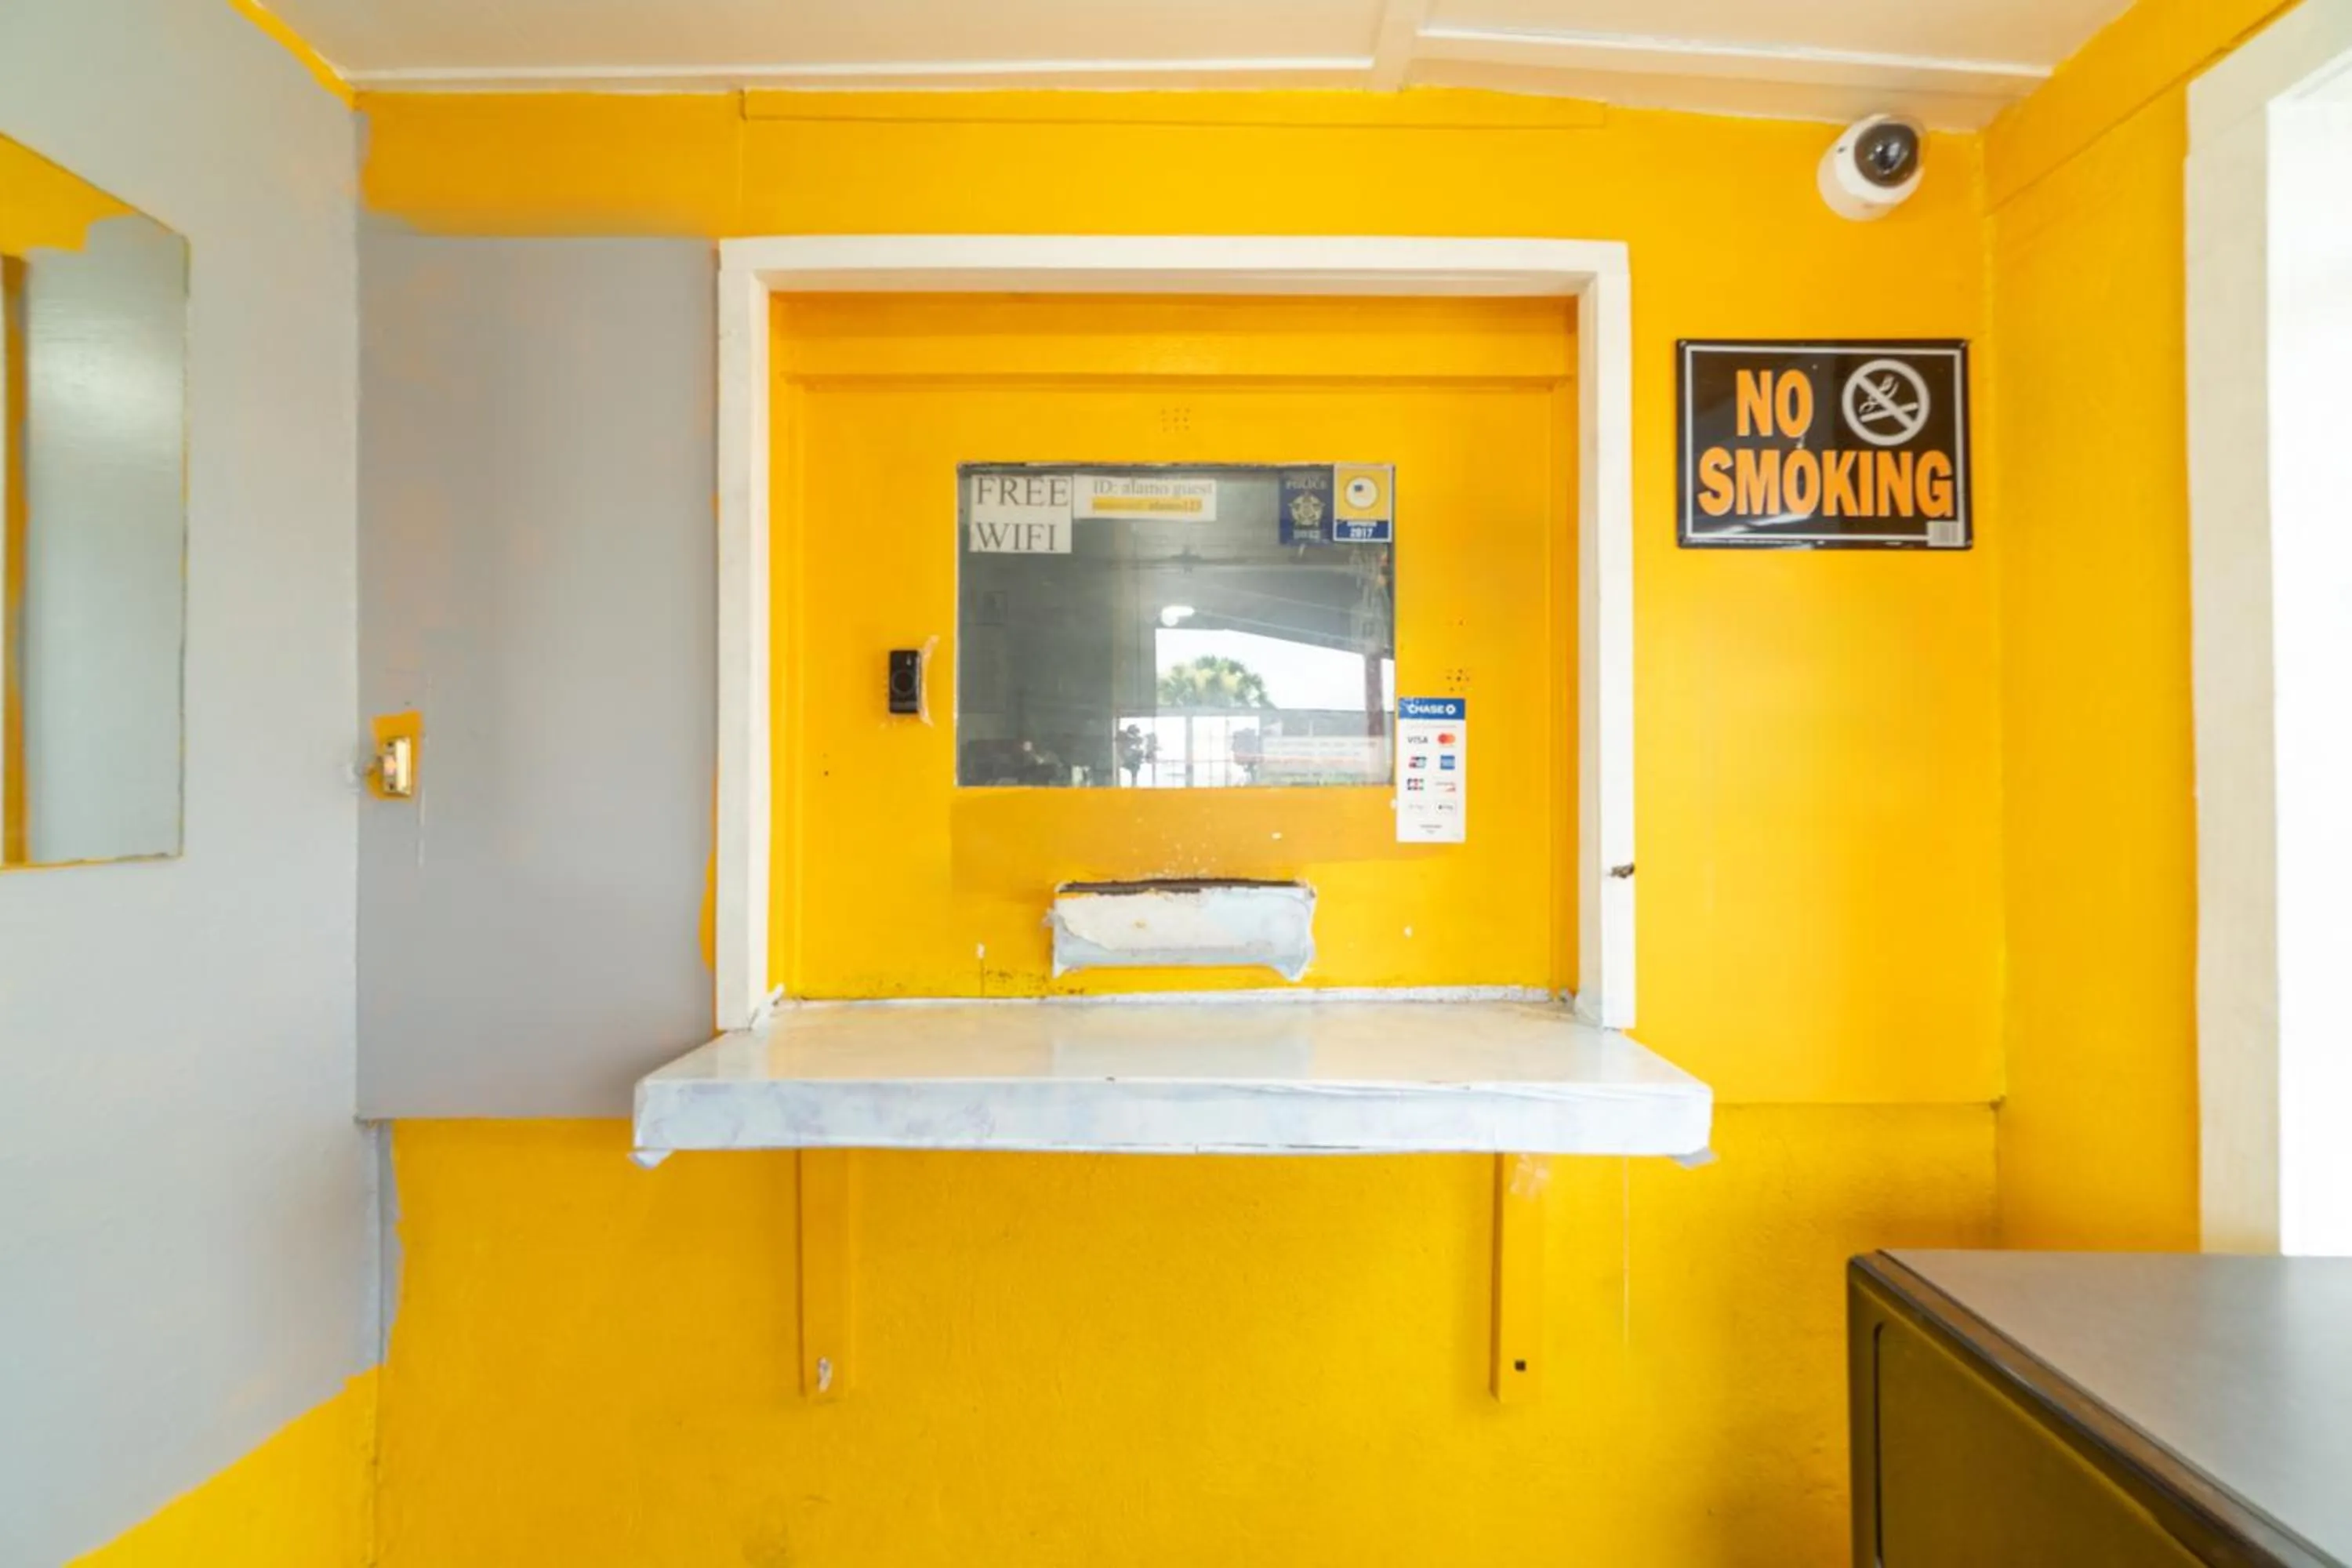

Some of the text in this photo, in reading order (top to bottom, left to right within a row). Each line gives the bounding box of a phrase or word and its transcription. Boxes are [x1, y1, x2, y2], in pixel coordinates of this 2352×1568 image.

[1736, 369, 1813, 437] NO
[976, 477, 1069, 507] FREE
[1093, 478, 1213, 498] ID: alamo guest
[1697, 447, 1954, 517] SMOKING
[975, 523, 1057, 551] WIFI
[1349, 527, 1374, 539] 2017
[1406, 704, 1445, 715] CHASE
[1407, 735, 1428, 744] VISA
